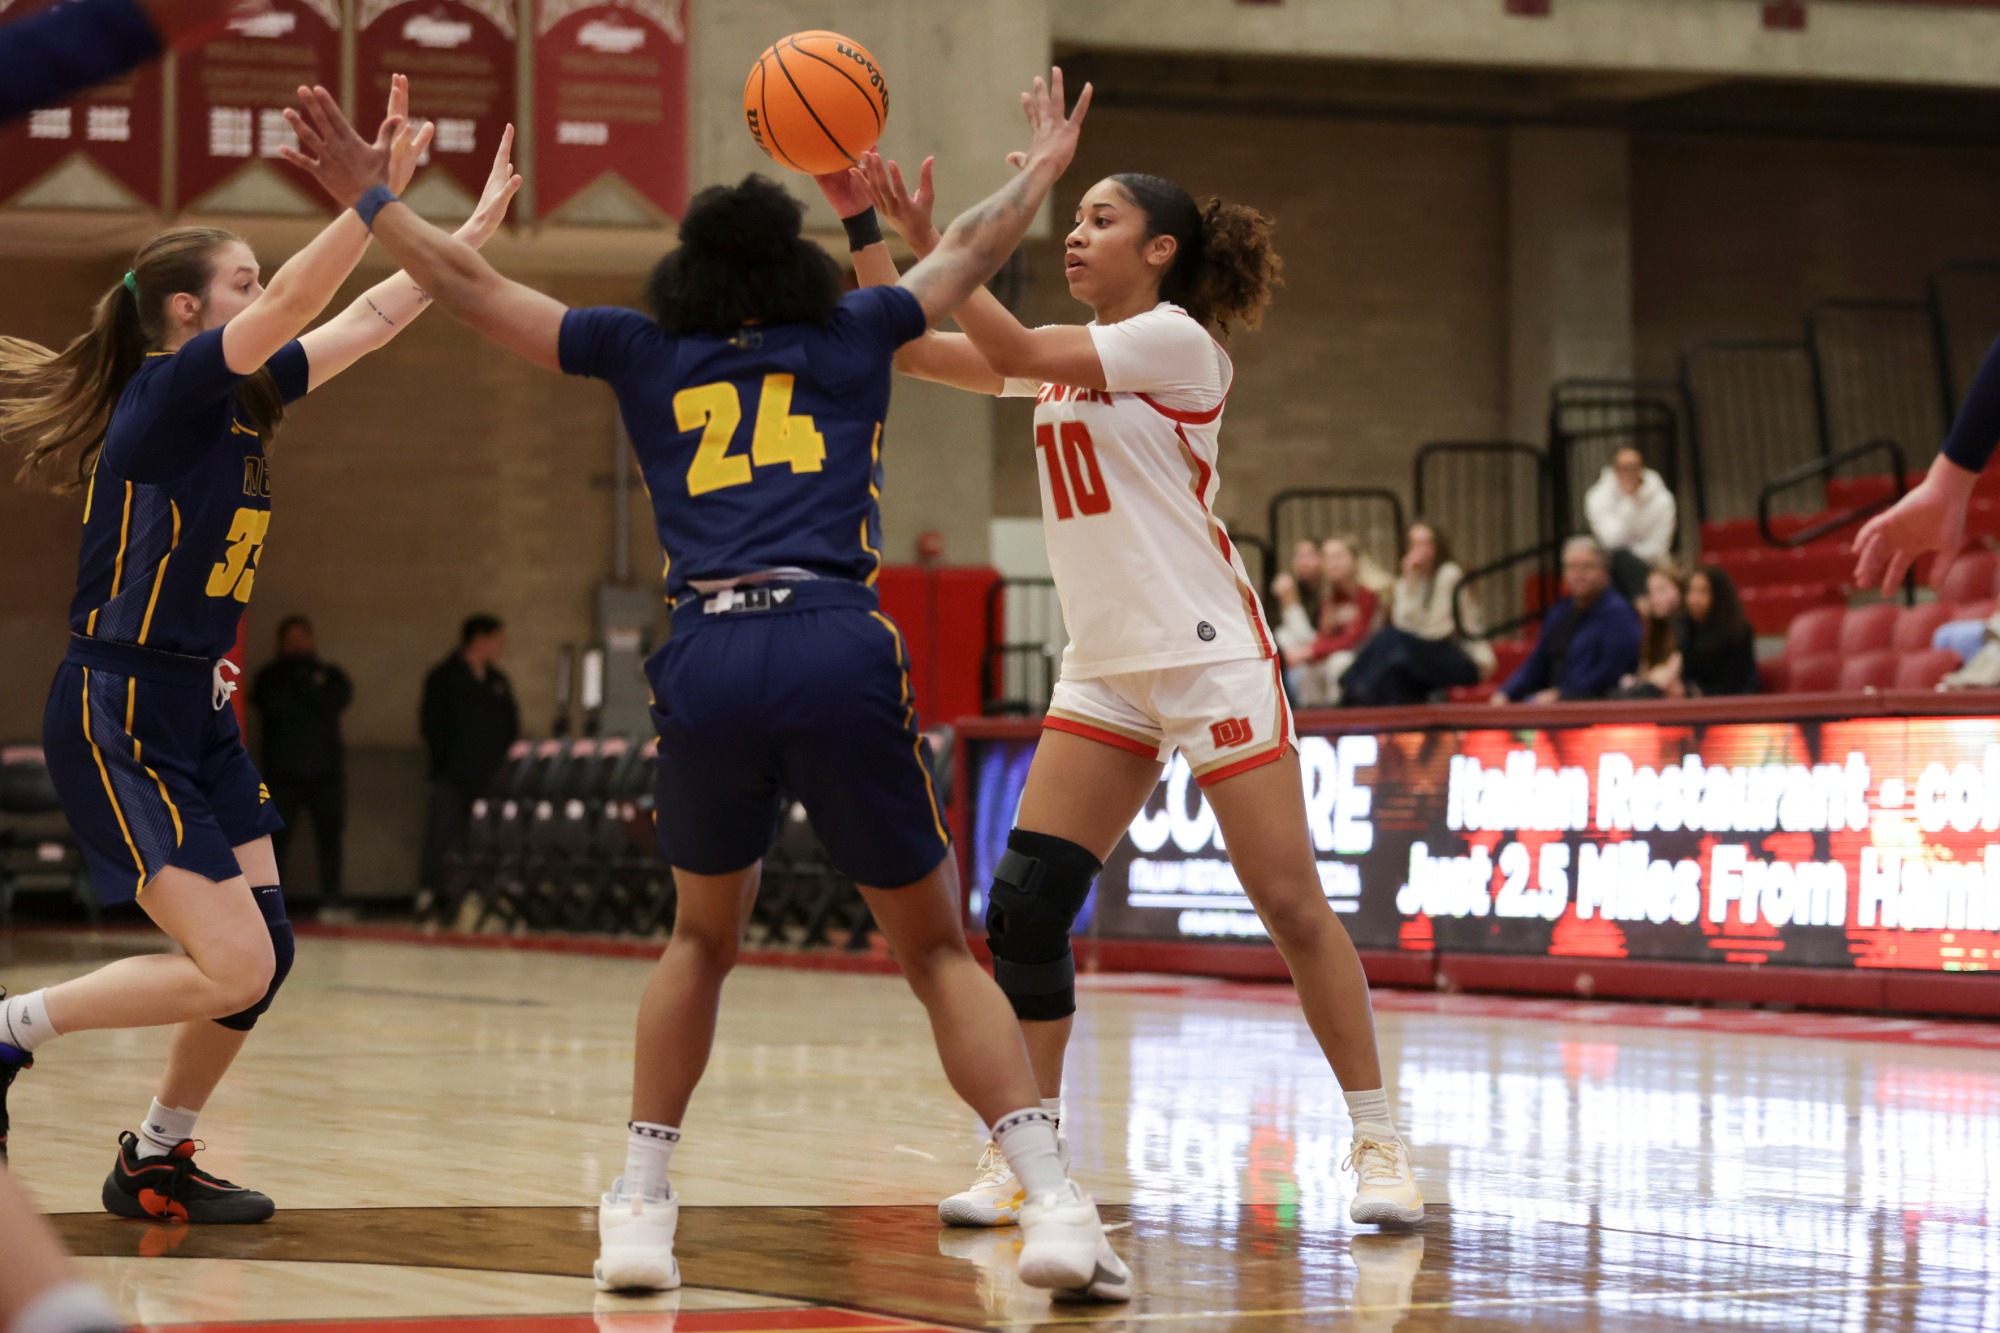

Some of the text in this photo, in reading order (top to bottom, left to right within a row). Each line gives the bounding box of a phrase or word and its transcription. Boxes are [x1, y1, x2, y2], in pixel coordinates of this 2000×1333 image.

[672, 373, 827, 497] 24
[1036, 419, 1112, 521] 10
[1447, 750, 1589, 831] Italian
[1596, 752, 1869, 832] Restaurant
[1396, 841, 1492, 917] Just
[1494, 842, 1570, 921] 2.5
[1576, 840, 1701, 924] Miles
[1709, 844, 1847, 927] From
